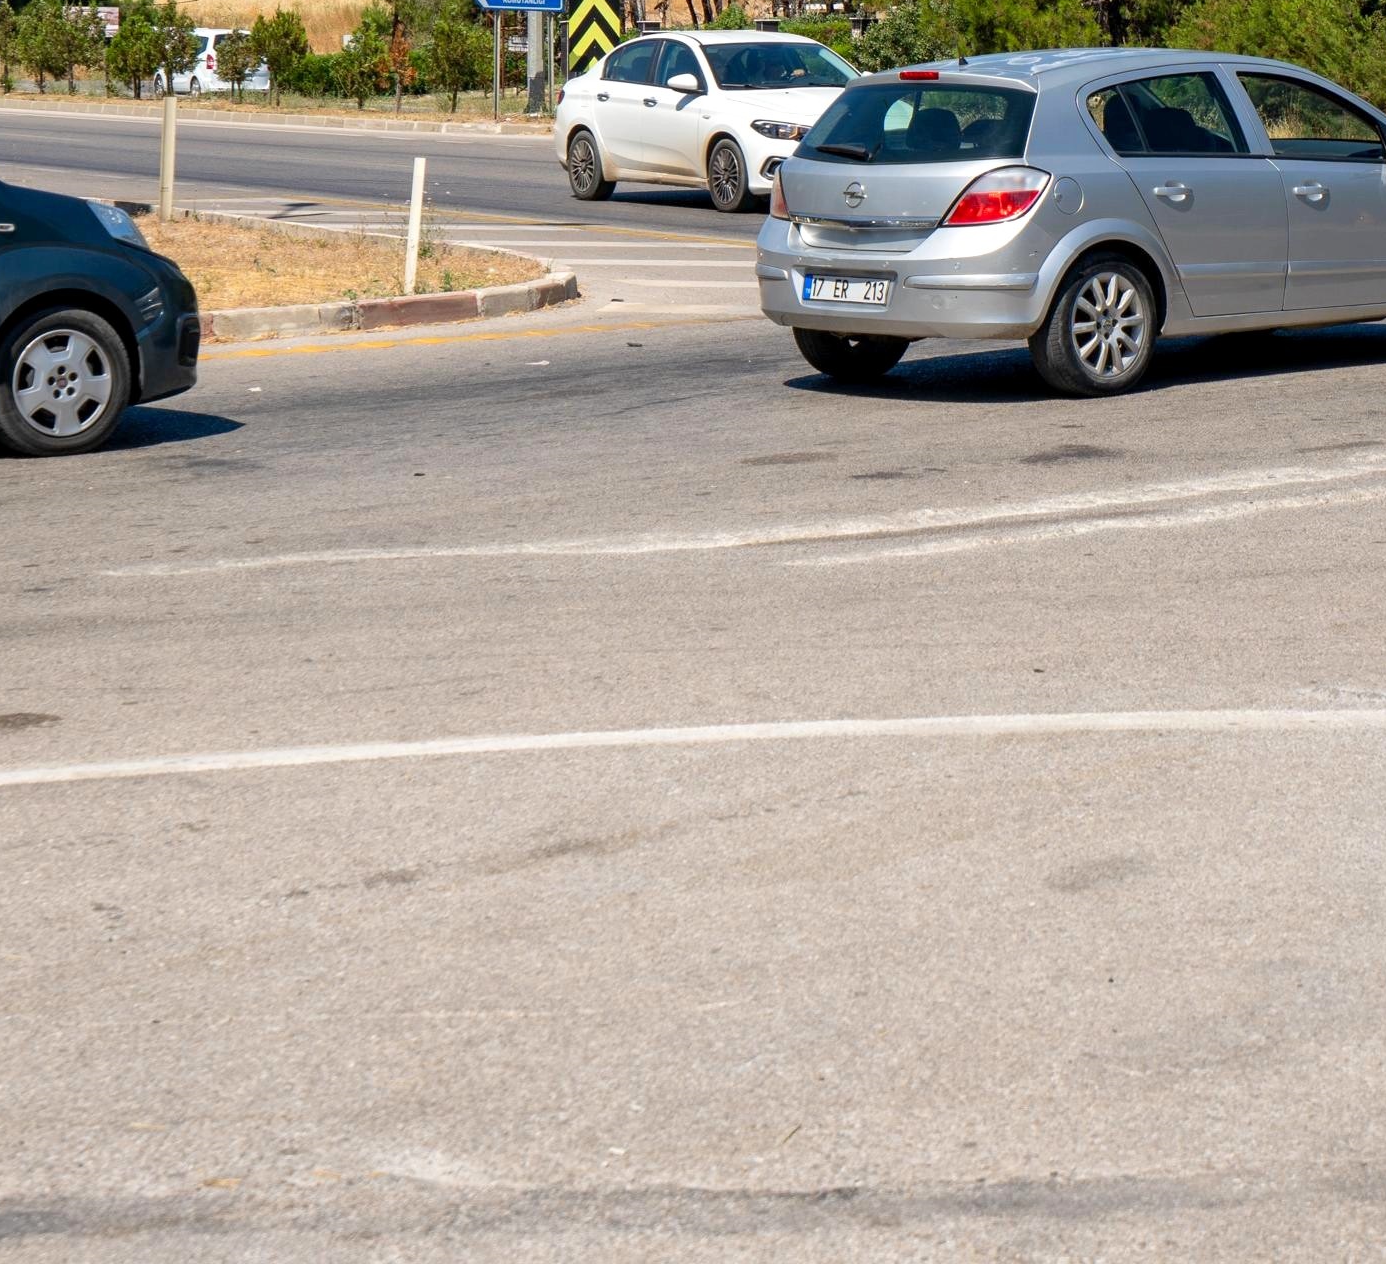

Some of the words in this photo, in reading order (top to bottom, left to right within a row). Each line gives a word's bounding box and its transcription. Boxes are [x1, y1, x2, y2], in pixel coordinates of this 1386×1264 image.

[813, 278, 825, 297] 17
[833, 279, 849, 299] ER
[864, 281, 885, 301] 213
